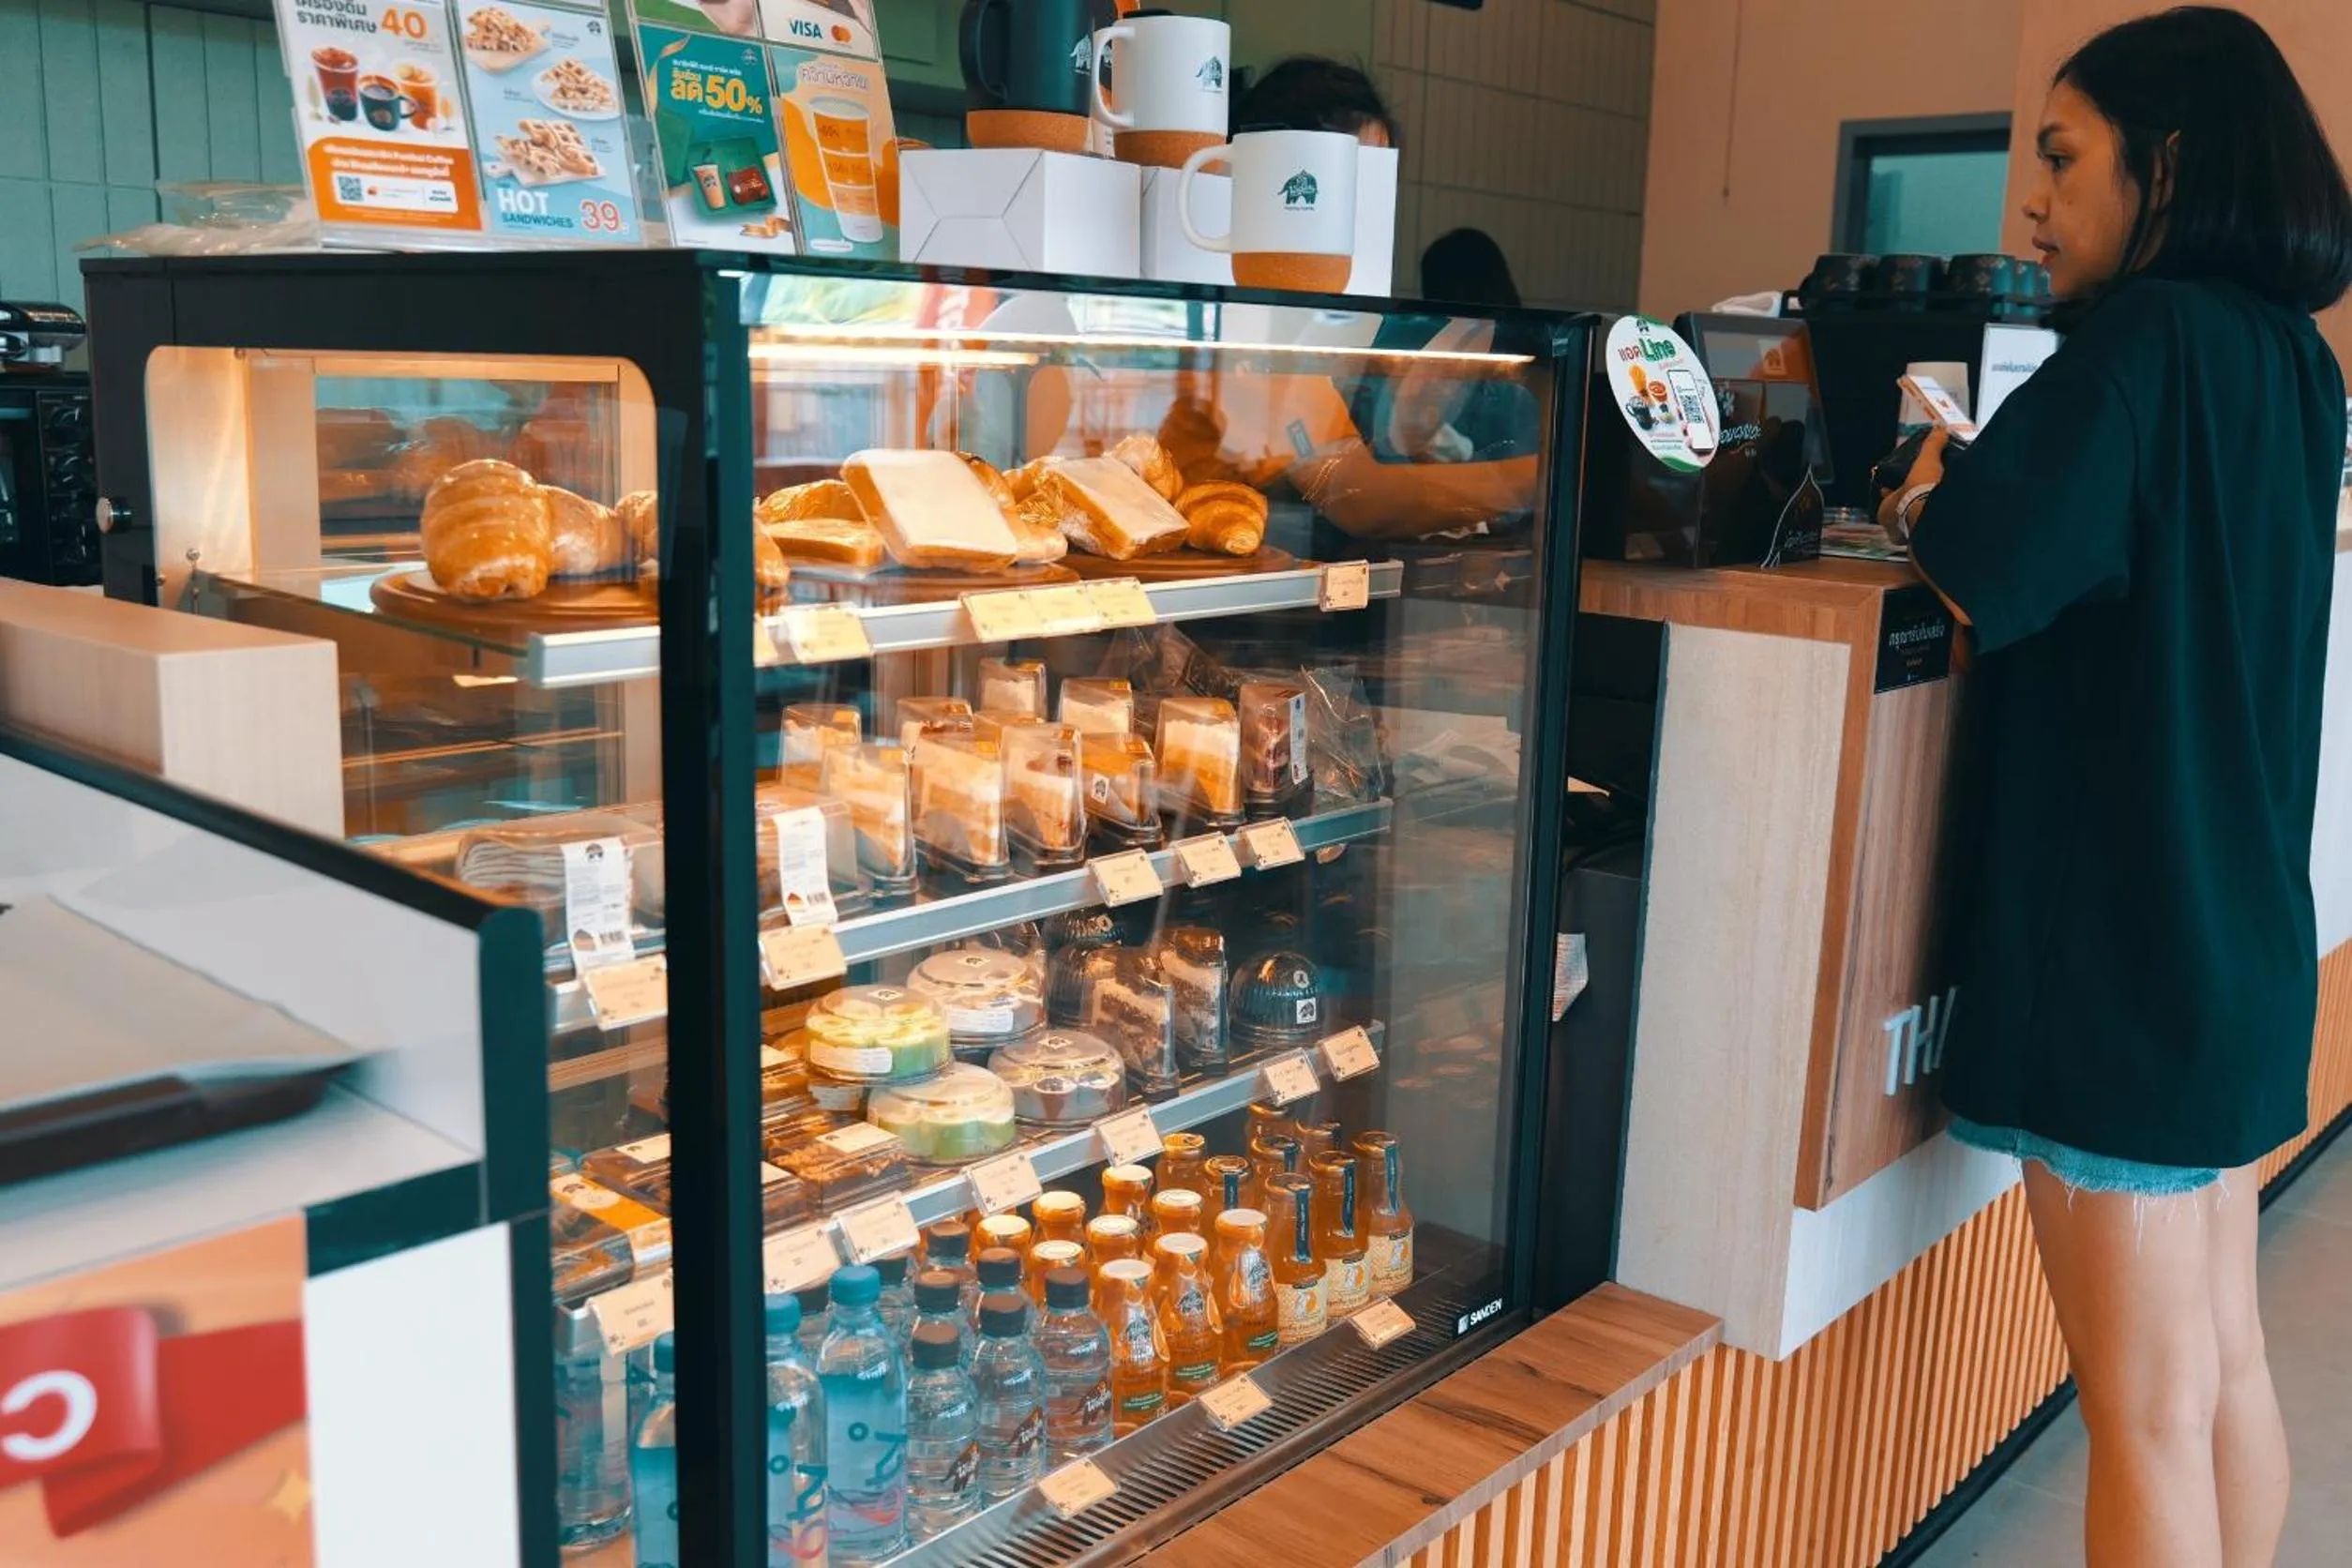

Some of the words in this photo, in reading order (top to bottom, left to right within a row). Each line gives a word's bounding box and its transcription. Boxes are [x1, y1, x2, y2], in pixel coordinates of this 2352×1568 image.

[296, 11, 377, 33] ราคาพิเศษ
[381, 8, 427, 39] 40
[790, 20, 823, 38] VISA
[497, 188, 549, 215] HOT
[502, 213, 574, 228] SANDWICHES
[580, 199, 620, 232] 39
[1470, 1298, 1502, 1325] SANDEN
